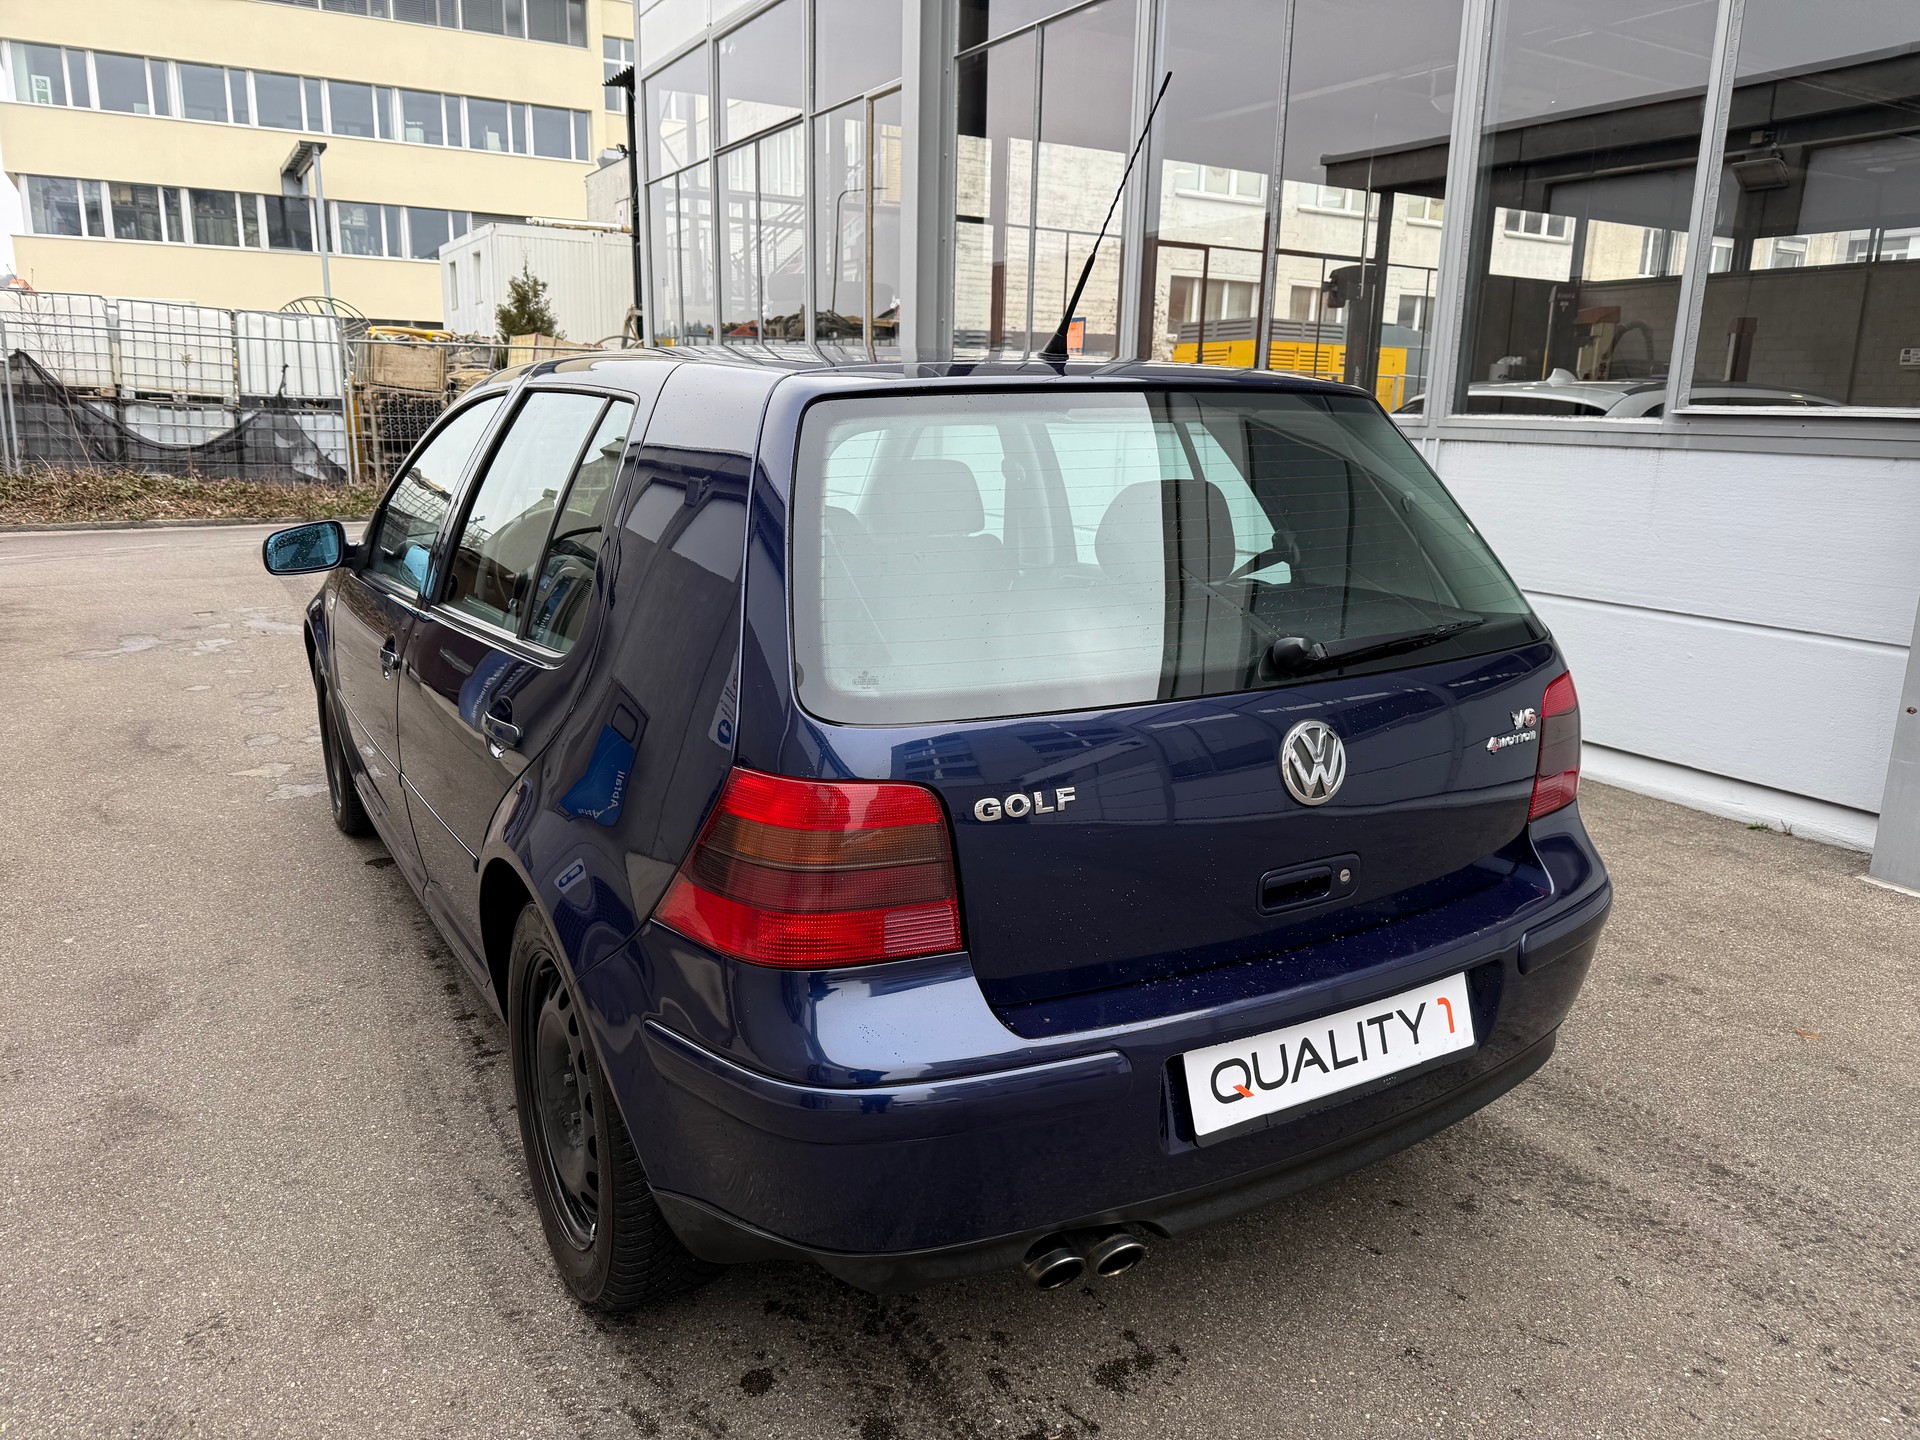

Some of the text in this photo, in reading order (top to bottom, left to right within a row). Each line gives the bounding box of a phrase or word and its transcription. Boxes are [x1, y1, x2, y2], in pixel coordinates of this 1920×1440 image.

[1510, 708, 1537, 730] V6
[1282, 720, 1346, 805] VW
[974, 786, 1076, 822] GOLF
[1210, 997, 1456, 1105] QUALITY 1
